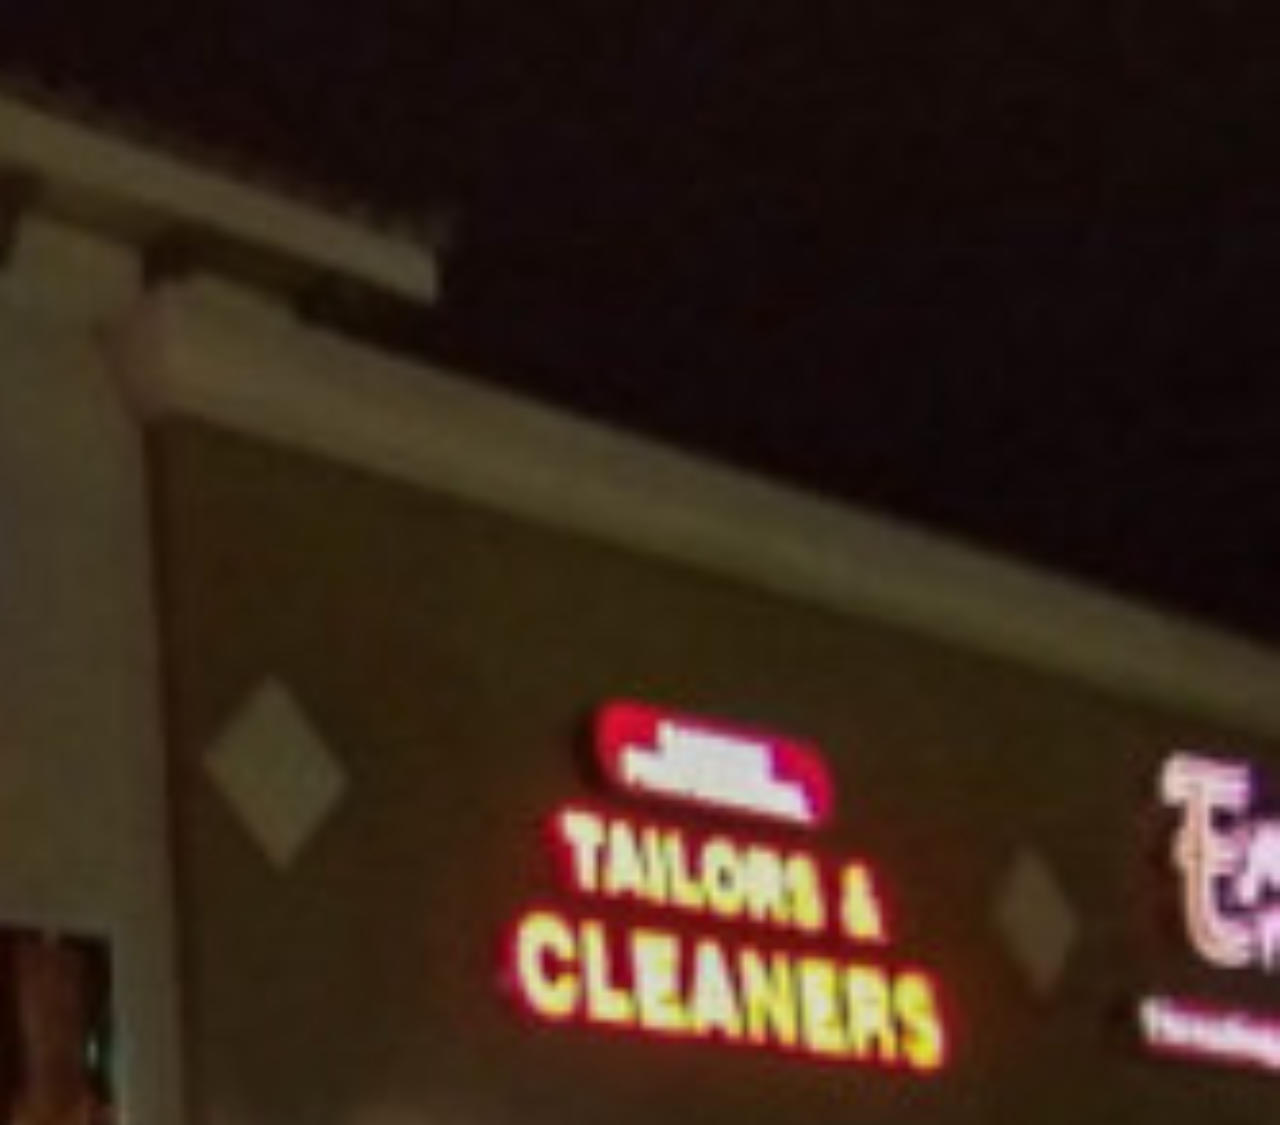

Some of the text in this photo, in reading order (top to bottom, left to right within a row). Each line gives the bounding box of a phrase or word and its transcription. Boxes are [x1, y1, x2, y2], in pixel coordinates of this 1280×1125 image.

[557, 810, 887, 942] TAILORS &
[514, 912, 947, 1071] CLEANERS
